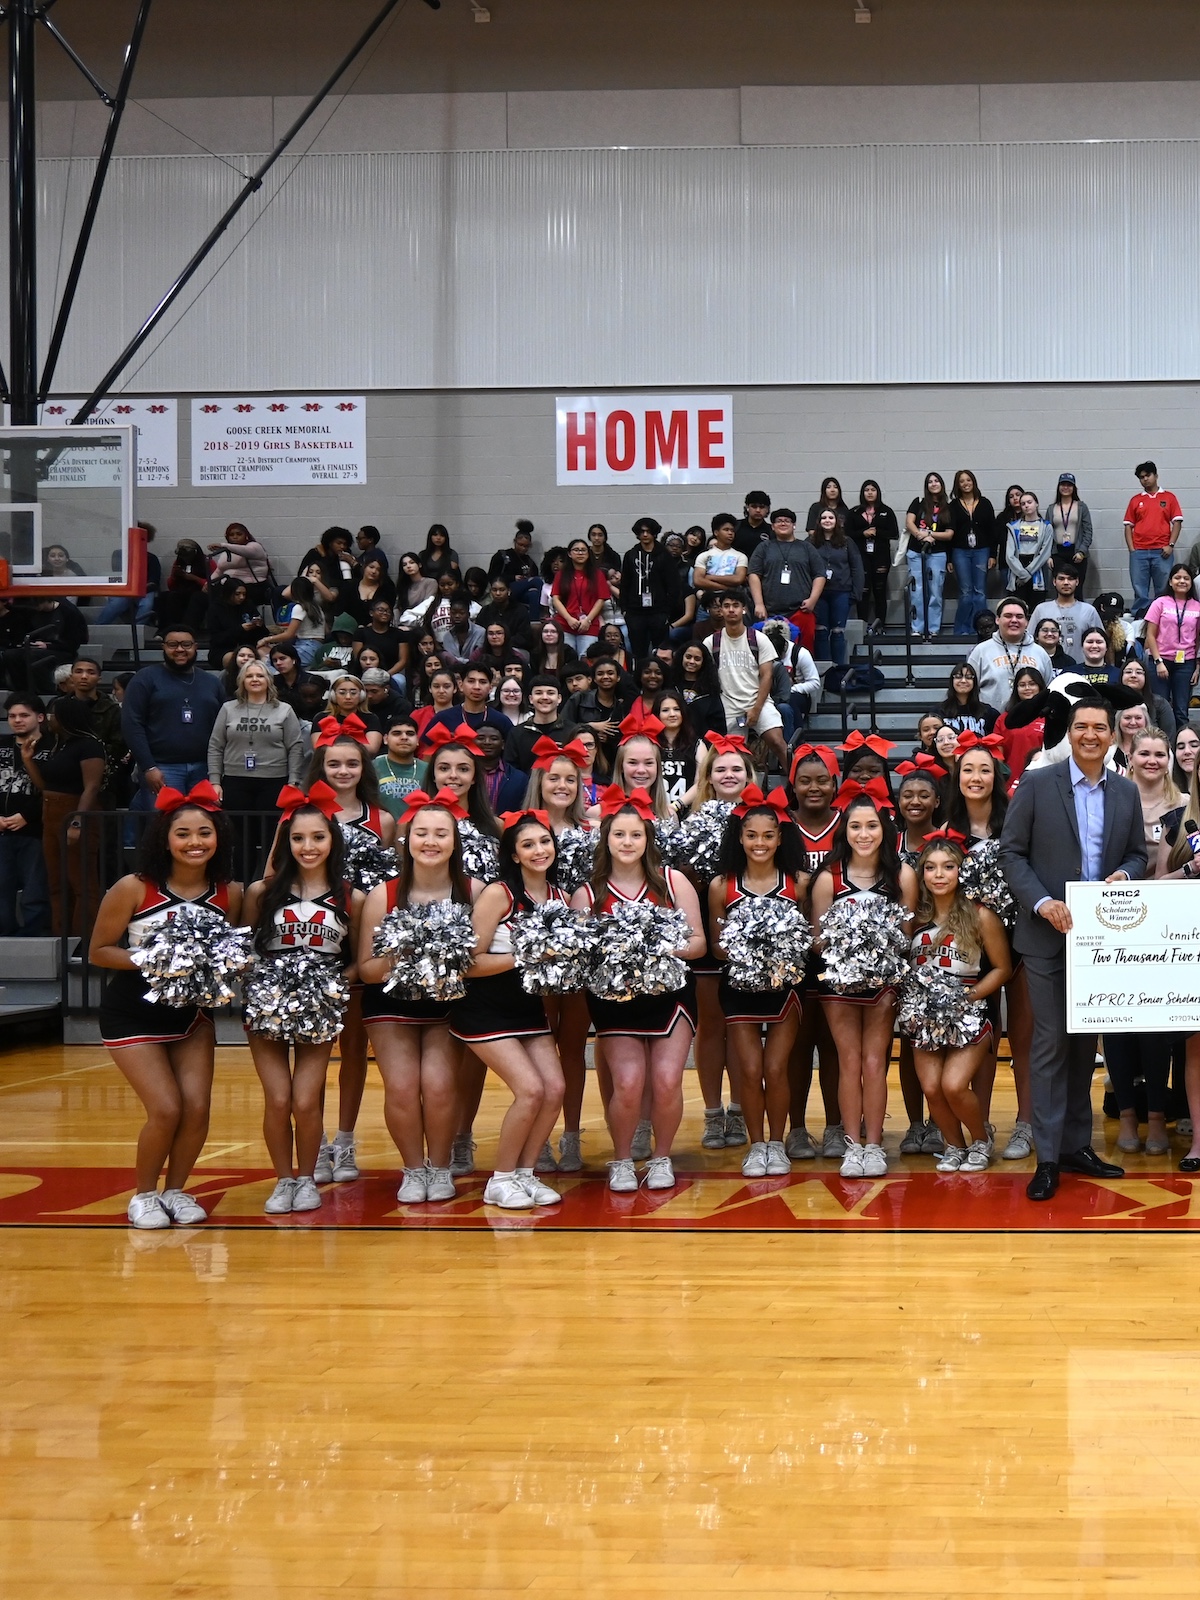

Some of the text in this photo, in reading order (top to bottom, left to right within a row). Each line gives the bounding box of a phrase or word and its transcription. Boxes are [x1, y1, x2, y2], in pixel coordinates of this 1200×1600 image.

[65, 418, 115, 426] CMPIONS
[226, 425, 332, 435] GOOSE CREEK MEMORIAL
[566, 409, 725, 471] HOME
[203, 441, 260, 451] 2018-2019
[200, 464, 274, 473] BI-DISTRICT CHAMPIONS
[327, 463, 358, 471] FINALISTS
[200, 473, 227, 481] DISTRICT
[312, 472, 338, 480] OVERALL
[993, 654, 1037, 667] TEXAS
[236, 724, 271, 732] MOM
[1110, 898, 1132, 906] Senior
[1101, 905, 1142, 914] Scholarship
[1091, 948, 1112, 965] Two
[1113, 947, 1169, 964] Thousand
[1171, 947, 1195, 963] Five
[1087, 993, 1126, 1007] KPRC
[1127, 993, 1134, 1005] 2
[1136, 992, 1164, 1005] Senior
